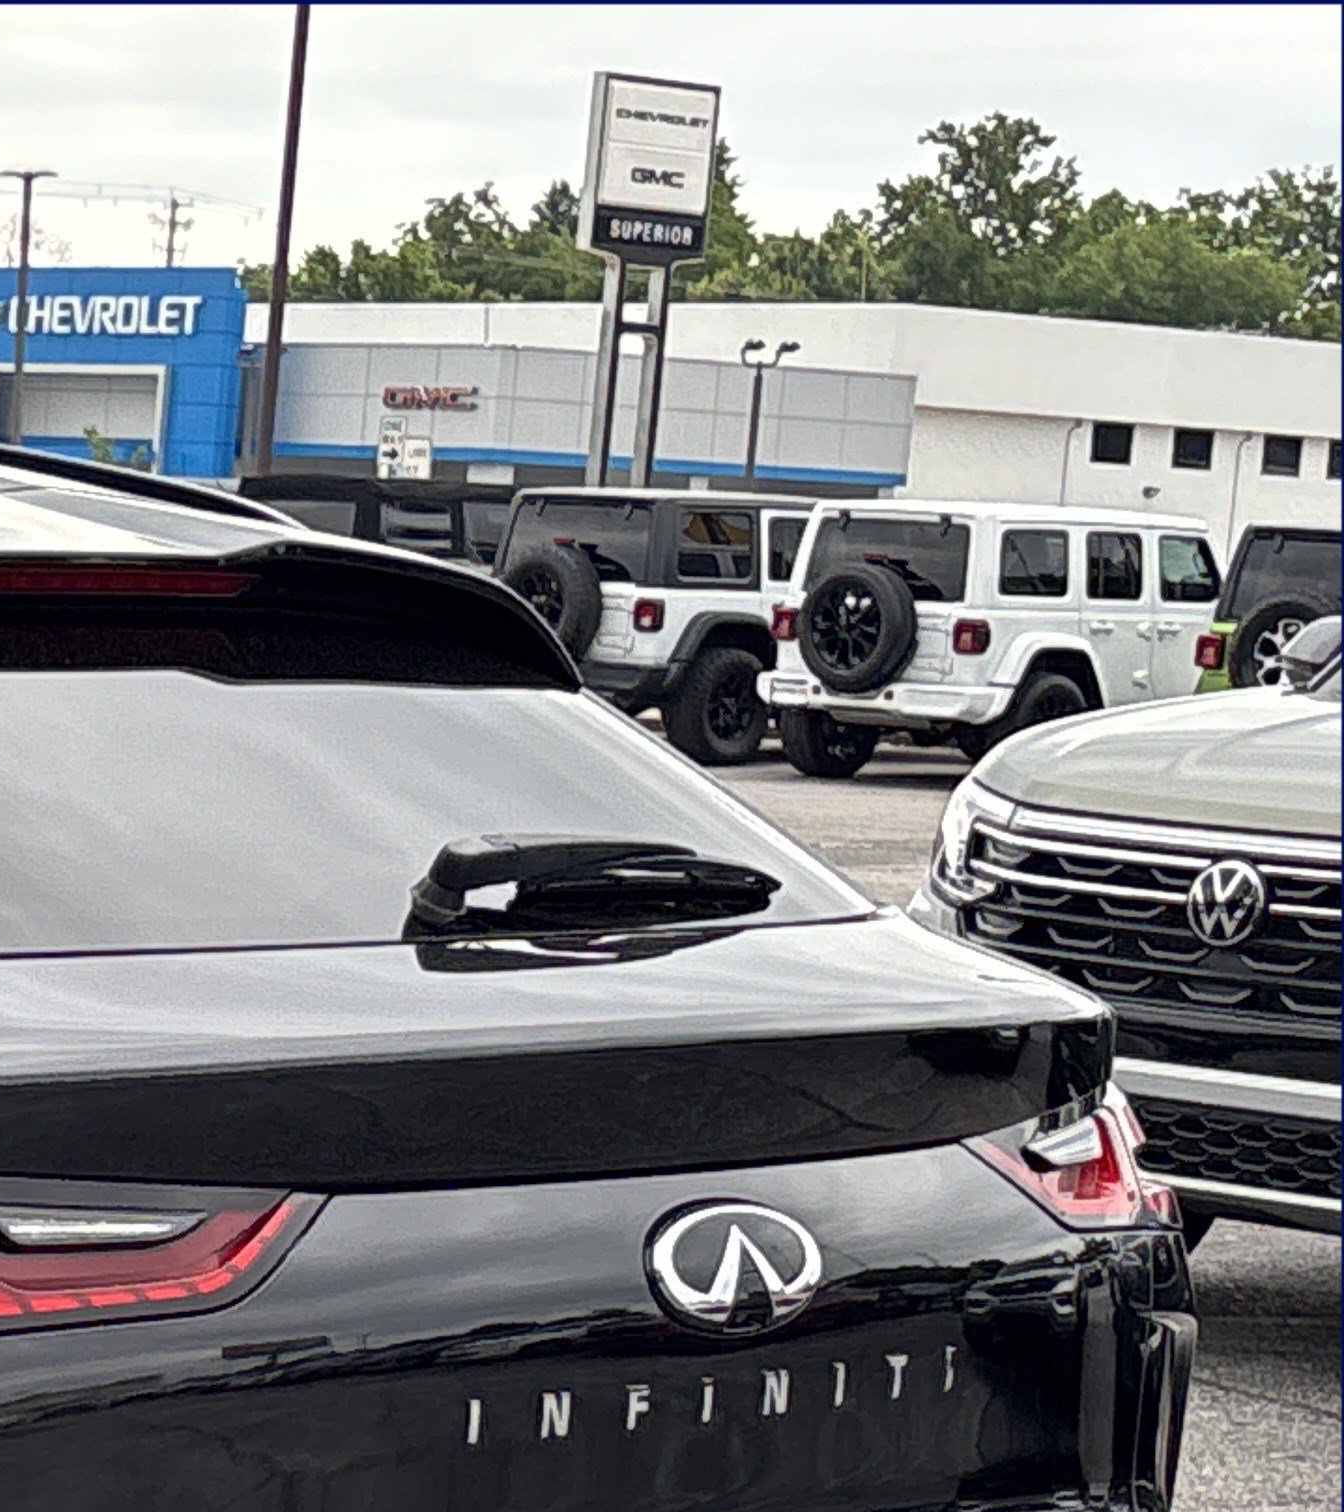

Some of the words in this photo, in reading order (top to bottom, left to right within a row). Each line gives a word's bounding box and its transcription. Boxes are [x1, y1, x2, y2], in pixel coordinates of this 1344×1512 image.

[615, 108, 710, 129] CHEVROLET
[631, 167, 686, 190] GMC
[609, 219, 694, 246] SUPERIOR
[8, 295, 203, 336] CHEVROLET
[381, 385, 479, 411] GMC
[465, 1344, 959, 1446] INFINITI
